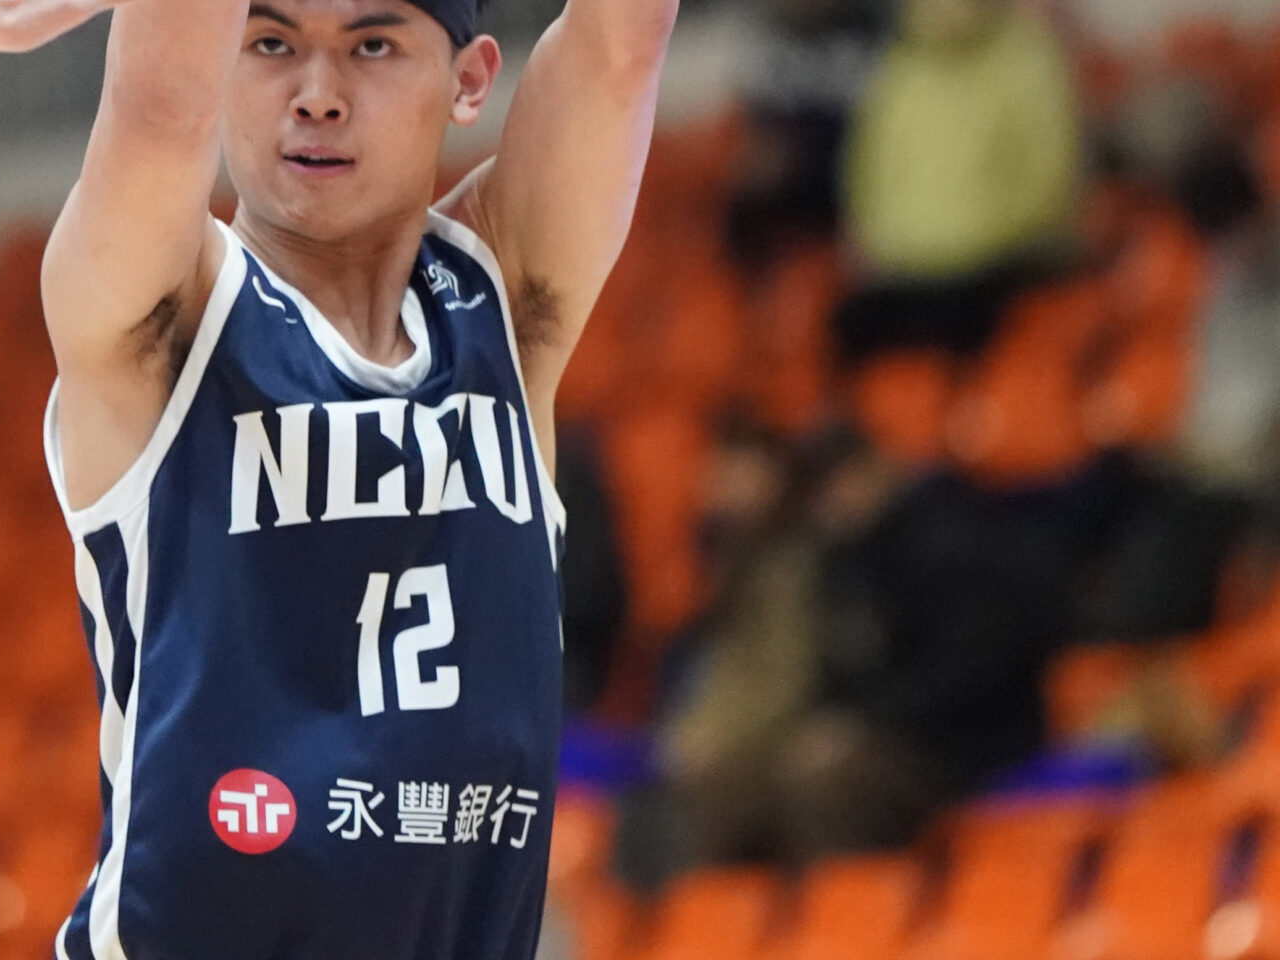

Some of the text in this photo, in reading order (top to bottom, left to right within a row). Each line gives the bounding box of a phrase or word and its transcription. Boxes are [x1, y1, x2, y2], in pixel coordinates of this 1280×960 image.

[356, 563, 460, 717] 12
[326, 778, 539, 849] 永豐銀行
